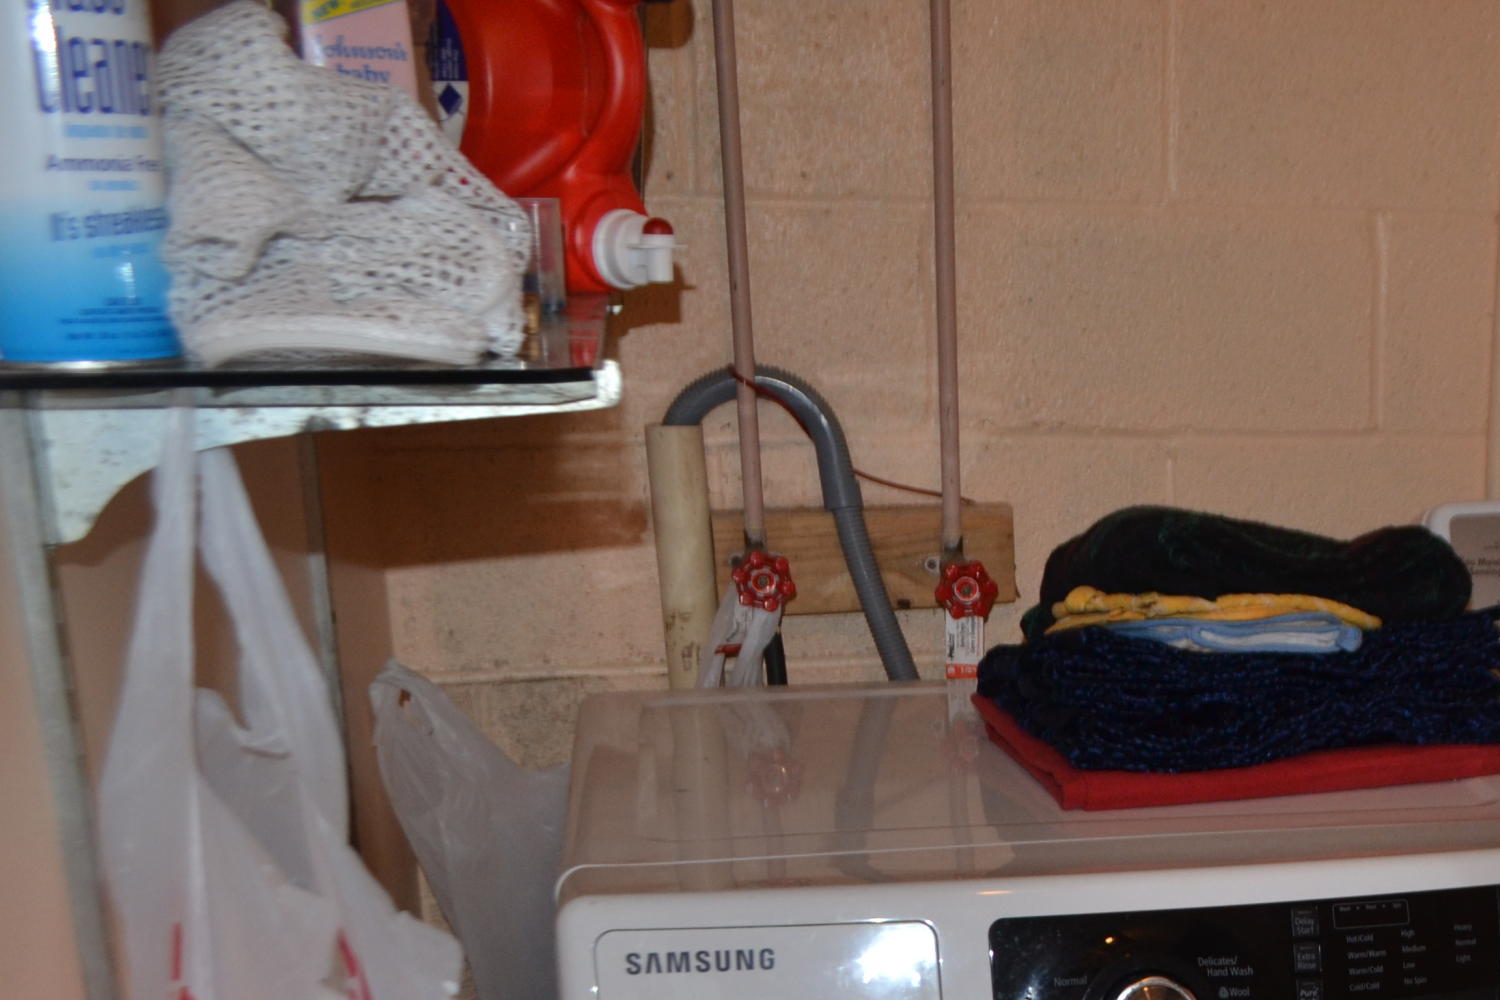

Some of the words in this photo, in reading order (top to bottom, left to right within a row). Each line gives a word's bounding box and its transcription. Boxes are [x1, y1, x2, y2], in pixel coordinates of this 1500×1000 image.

[625, 947, 775, 976] SAMSUNG
[1206, 967, 1229, 977] Hand
[1230, 966, 1254, 976] Wash
[1053, 976, 1087, 987] Normal
[1229, 986, 1250, 997] Wool
